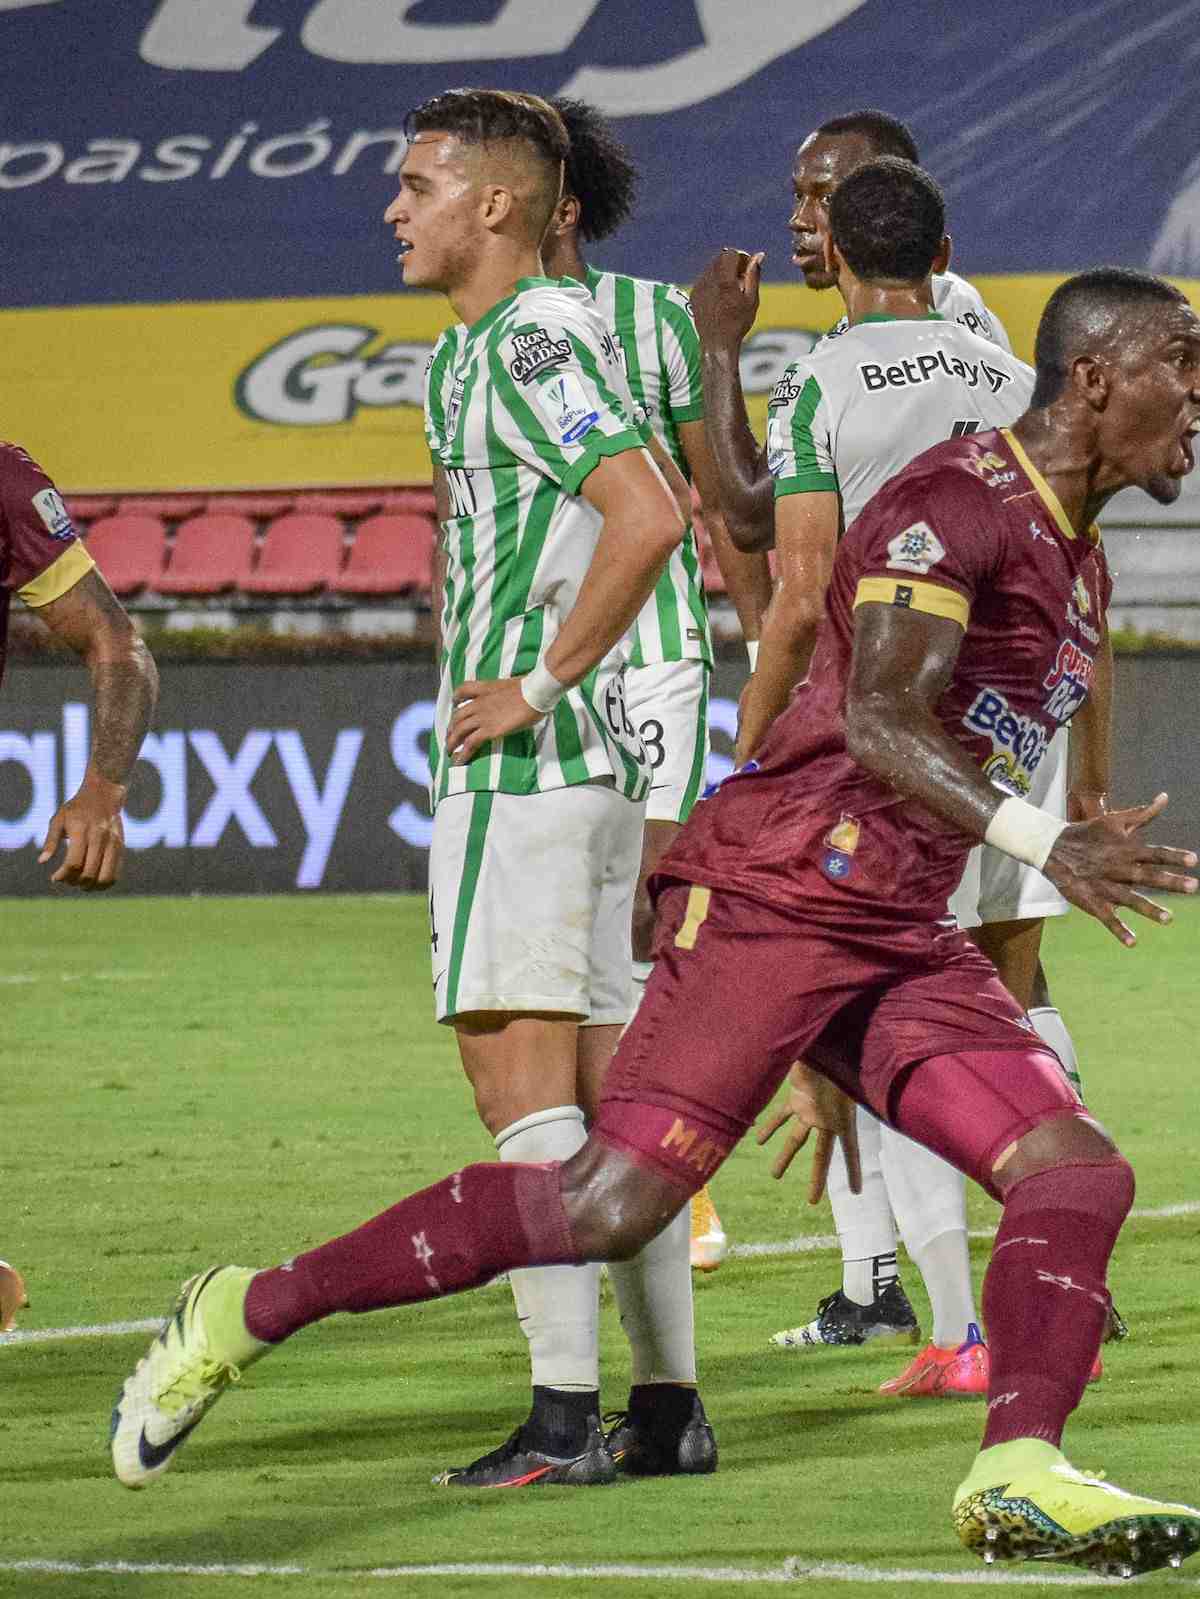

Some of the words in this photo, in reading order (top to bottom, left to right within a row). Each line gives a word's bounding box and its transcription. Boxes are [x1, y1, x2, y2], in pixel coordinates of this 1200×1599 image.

[0, 119, 404, 190] pasión
[511, 340, 571, 381] CALDAS
[512, 330, 548, 352] RON
[232, 321, 429, 426] Ga
[861, 351, 978, 391] BetPlay
[0, 702, 365, 888] alaxy
